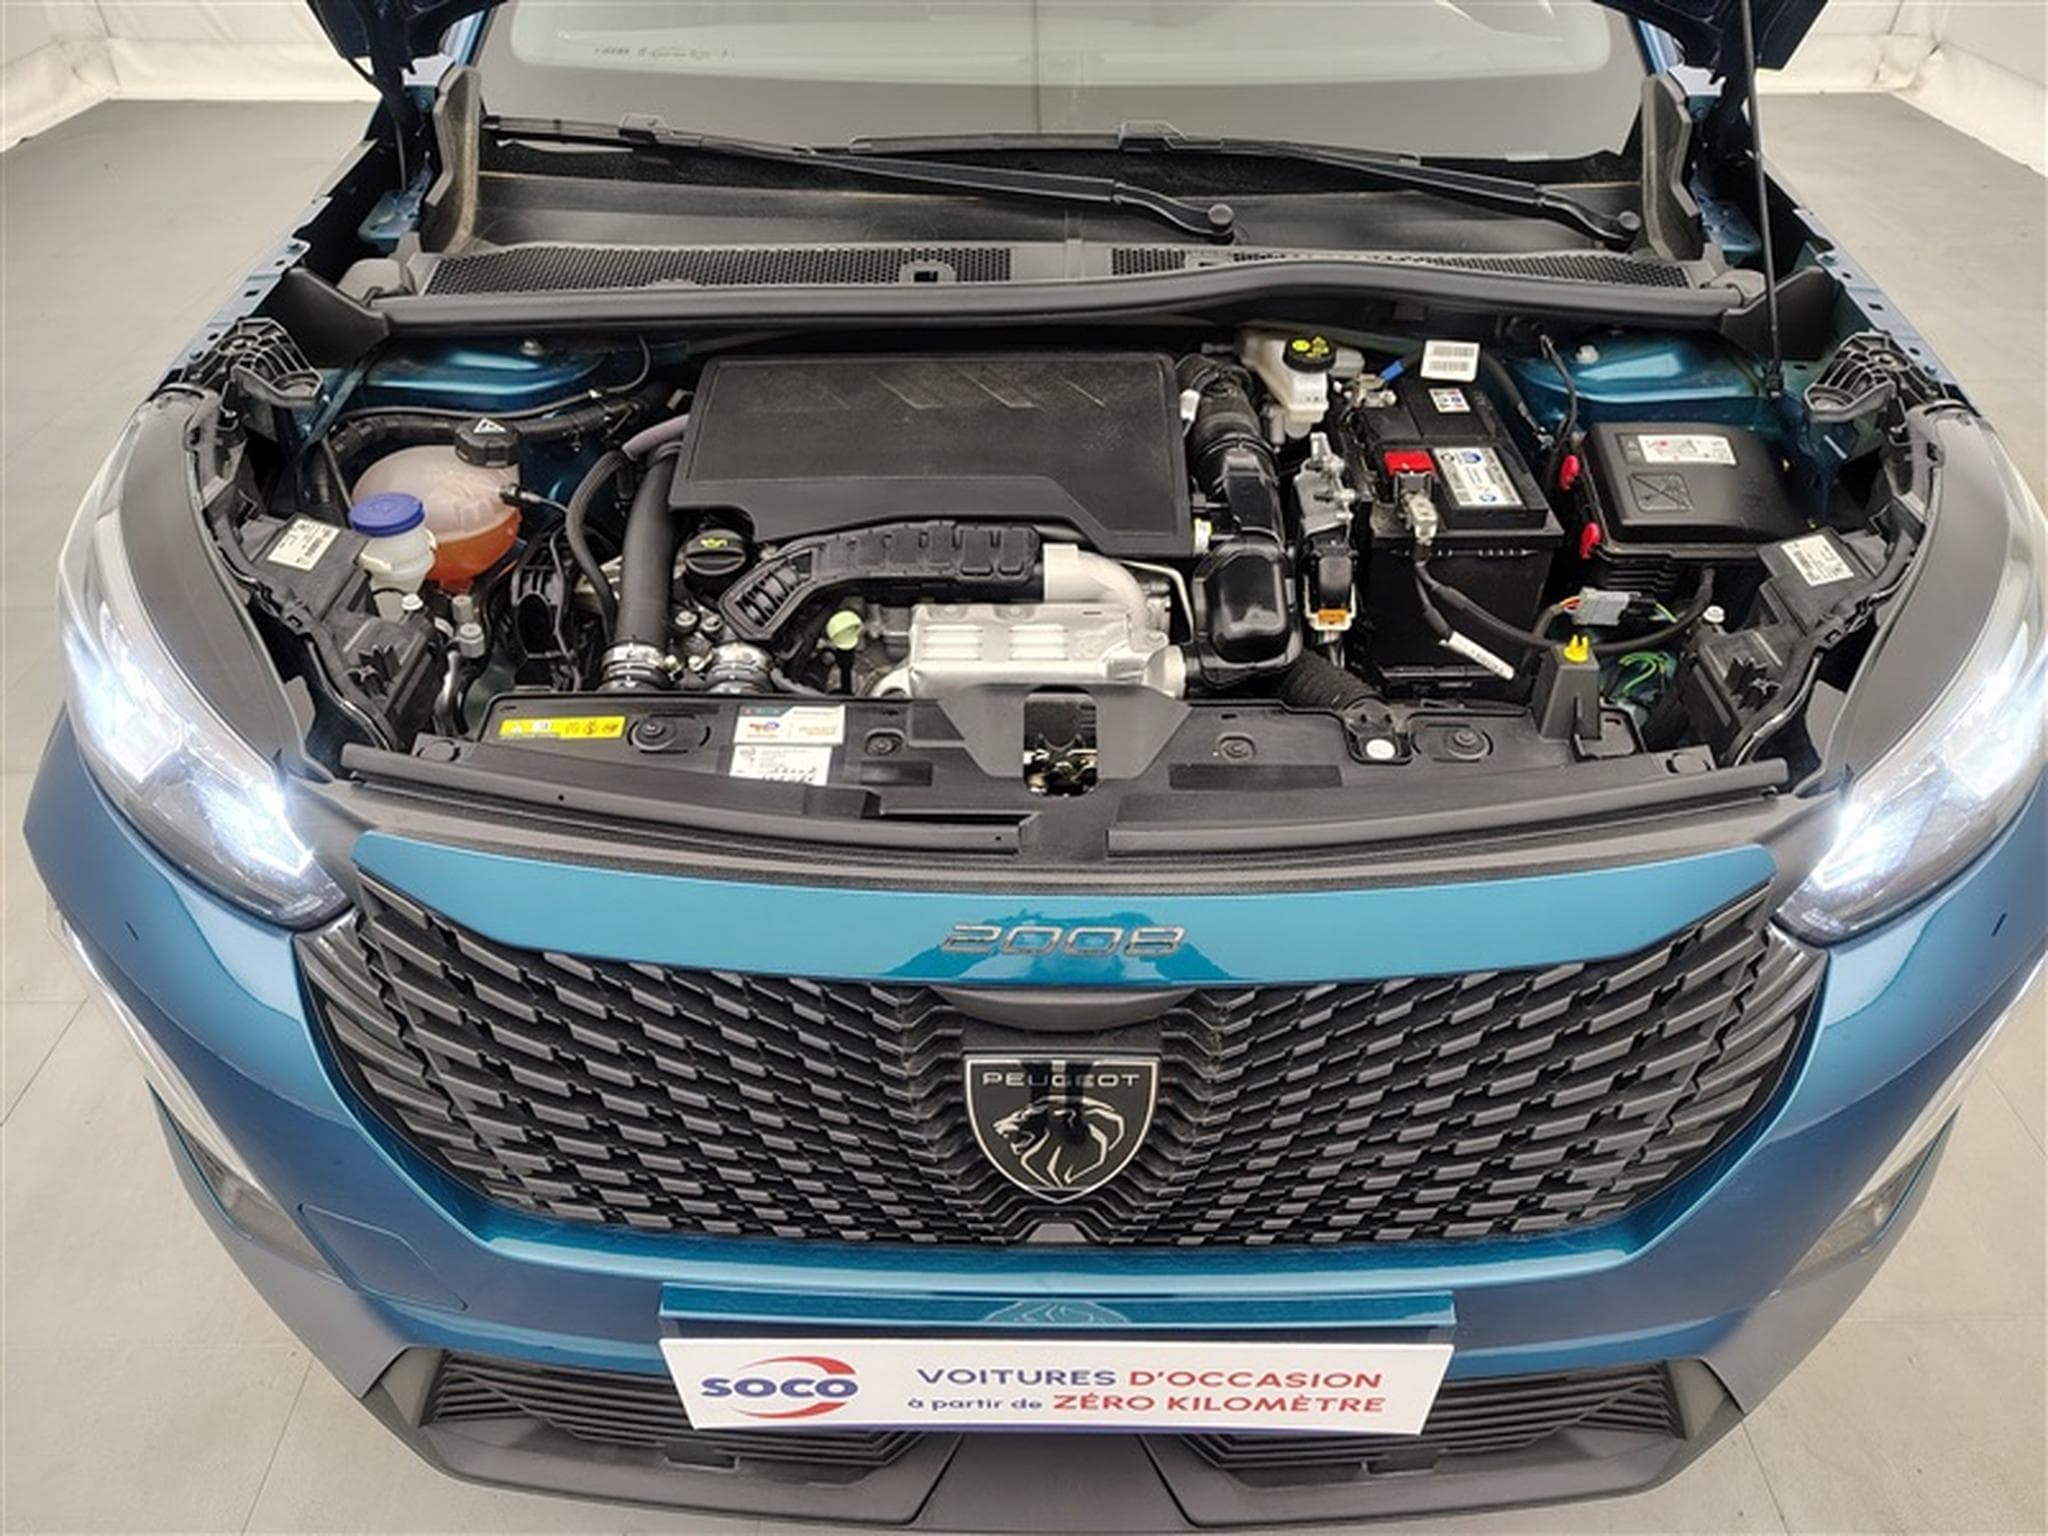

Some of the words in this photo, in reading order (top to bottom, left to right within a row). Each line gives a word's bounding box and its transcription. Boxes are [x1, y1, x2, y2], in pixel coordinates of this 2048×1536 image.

[941, 923, 1186, 958] 2008
[981, 1071, 1141, 1089] PEUGEOT
[700, 1377, 859, 1398] SOCO
[916, 1368, 1116, 1387] VOITURES
[1129, 1370, 1383, 1389] D'OCCASION
[907, 1396, 925, 1410] à
[930, 1397, 1005, 1412] partir
[1011, 1397, 1043, 1410] de
[1053, 1391, 1156, 1411] ZÉRO
[1166, 1394, 1387, 1413] KILOMÈTRE
